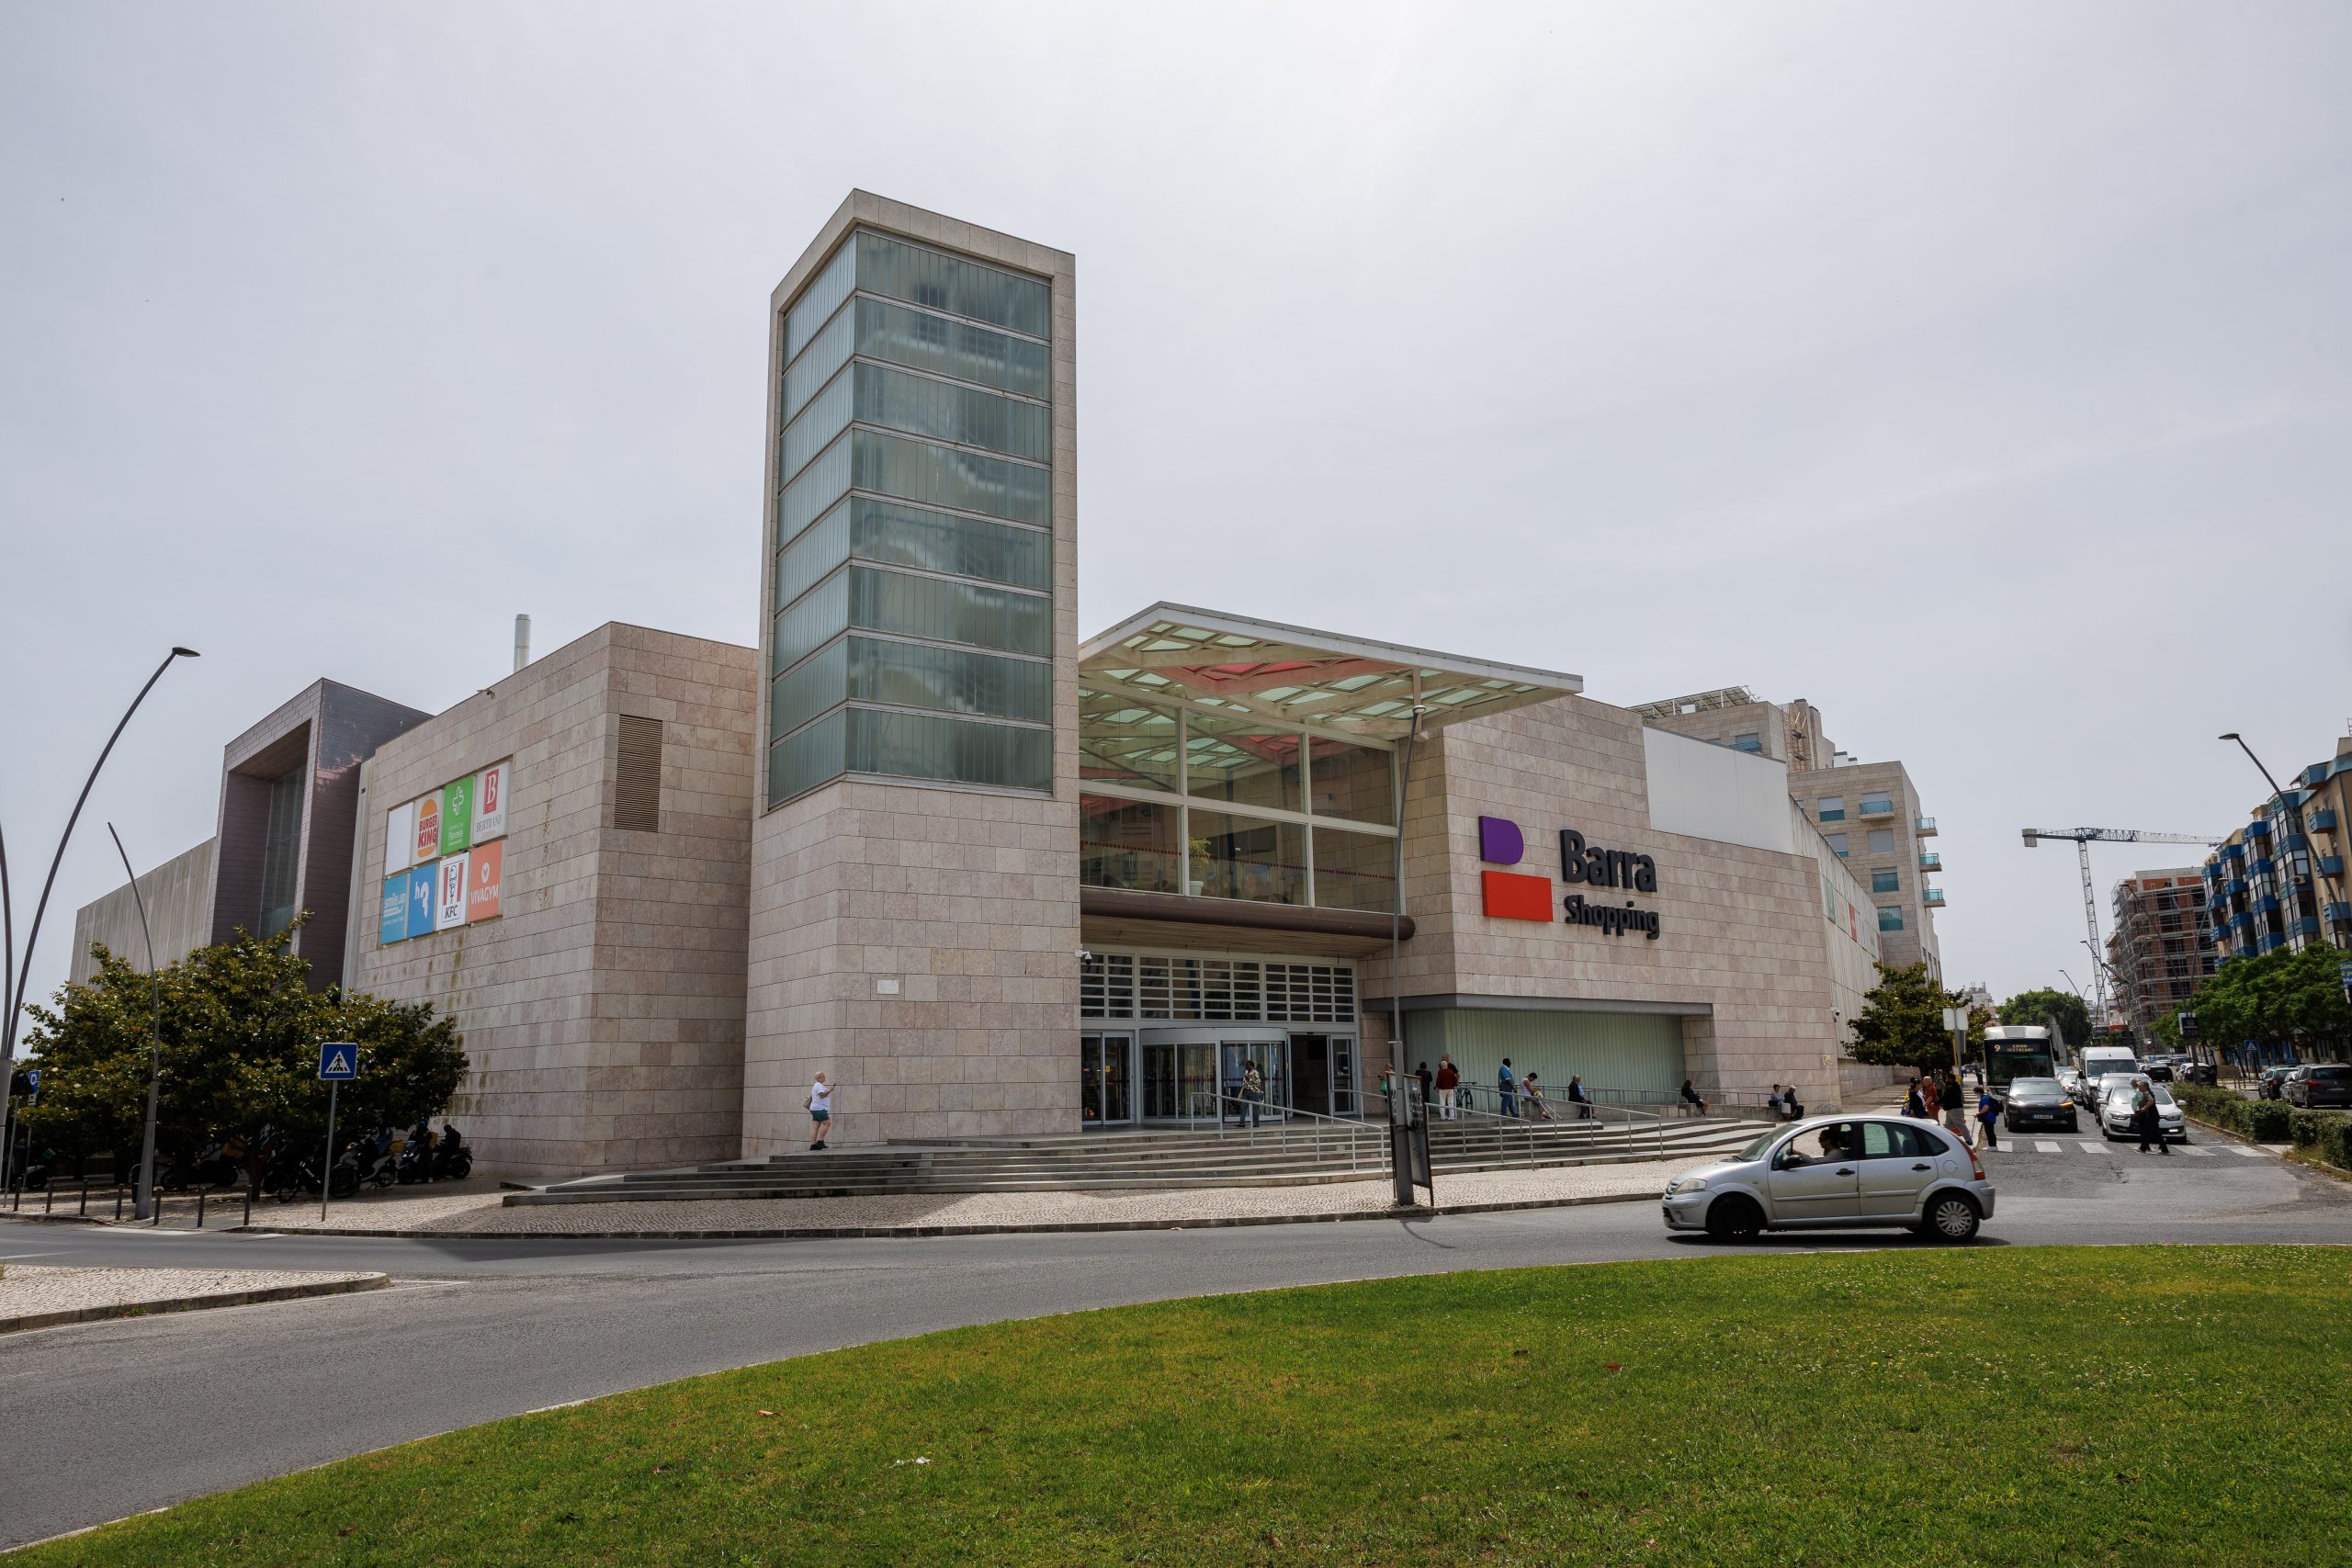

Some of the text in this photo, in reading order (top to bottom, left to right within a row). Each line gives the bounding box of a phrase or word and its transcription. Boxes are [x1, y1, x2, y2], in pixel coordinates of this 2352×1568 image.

[419, 814, 438, 832] BURGER
[475, 814, 502, 833] BERTRAND
[418, 828, 438, 848] KING
[1560, 829, 1657, 893] Barra
[471, 884, 498, 904] VIVAGYM
[445, 905, 458, 919] KFC
[1564, 895, 1660, 940] Shopping
